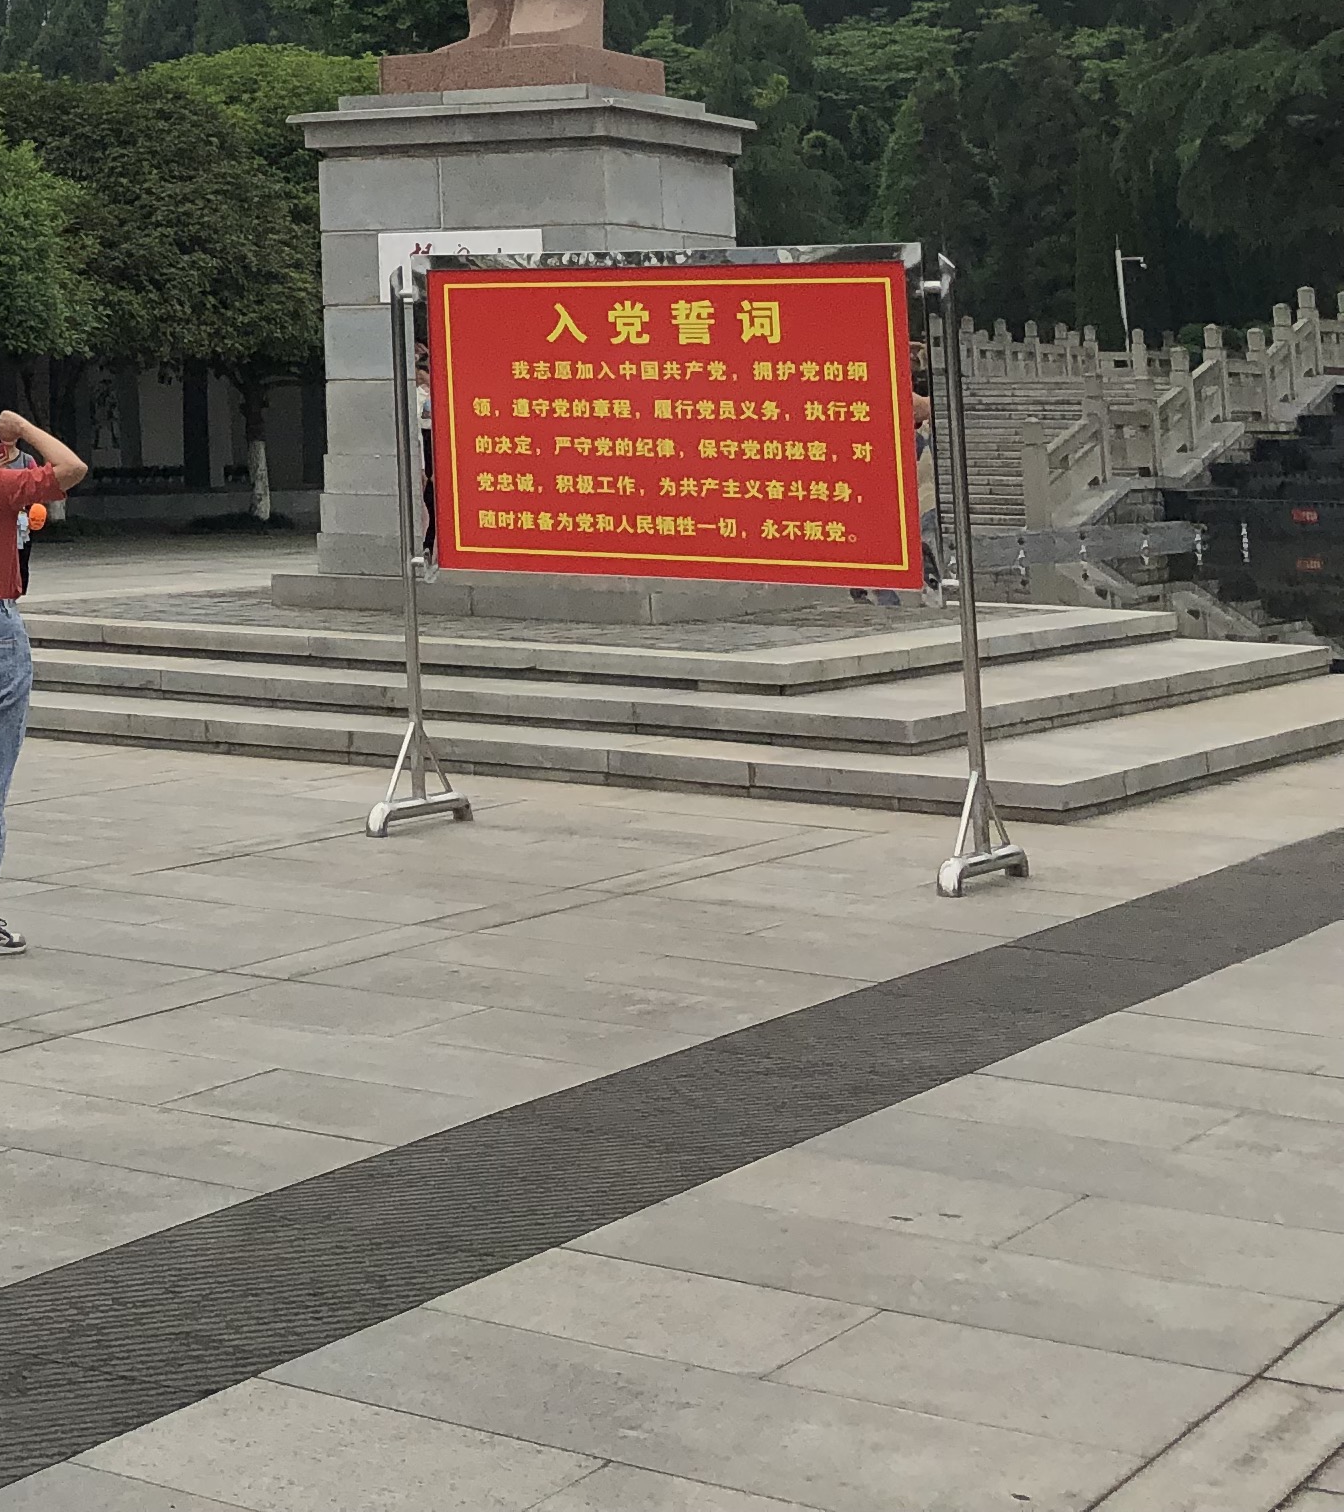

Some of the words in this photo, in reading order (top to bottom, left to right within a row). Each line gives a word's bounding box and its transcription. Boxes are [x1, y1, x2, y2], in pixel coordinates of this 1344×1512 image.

[546, 299, 782, 345] 入党誓词
[511, 360, 869, 383] 我志愿加入中国共产党，拥护党的纲
[472, 397, 872, 423] 领，遵守党的章程，履行党员义务，执行党
[475, 435, 874, 463] 的决定，严守党的纪律，保守党的秘密，对
[476, 471, 863, 504] 党忠诚，积极工作，为共产主义奋斗终身，
[478, 508, 859, 544] 随时准备为党和人民牺牲一切，永不叛党。
